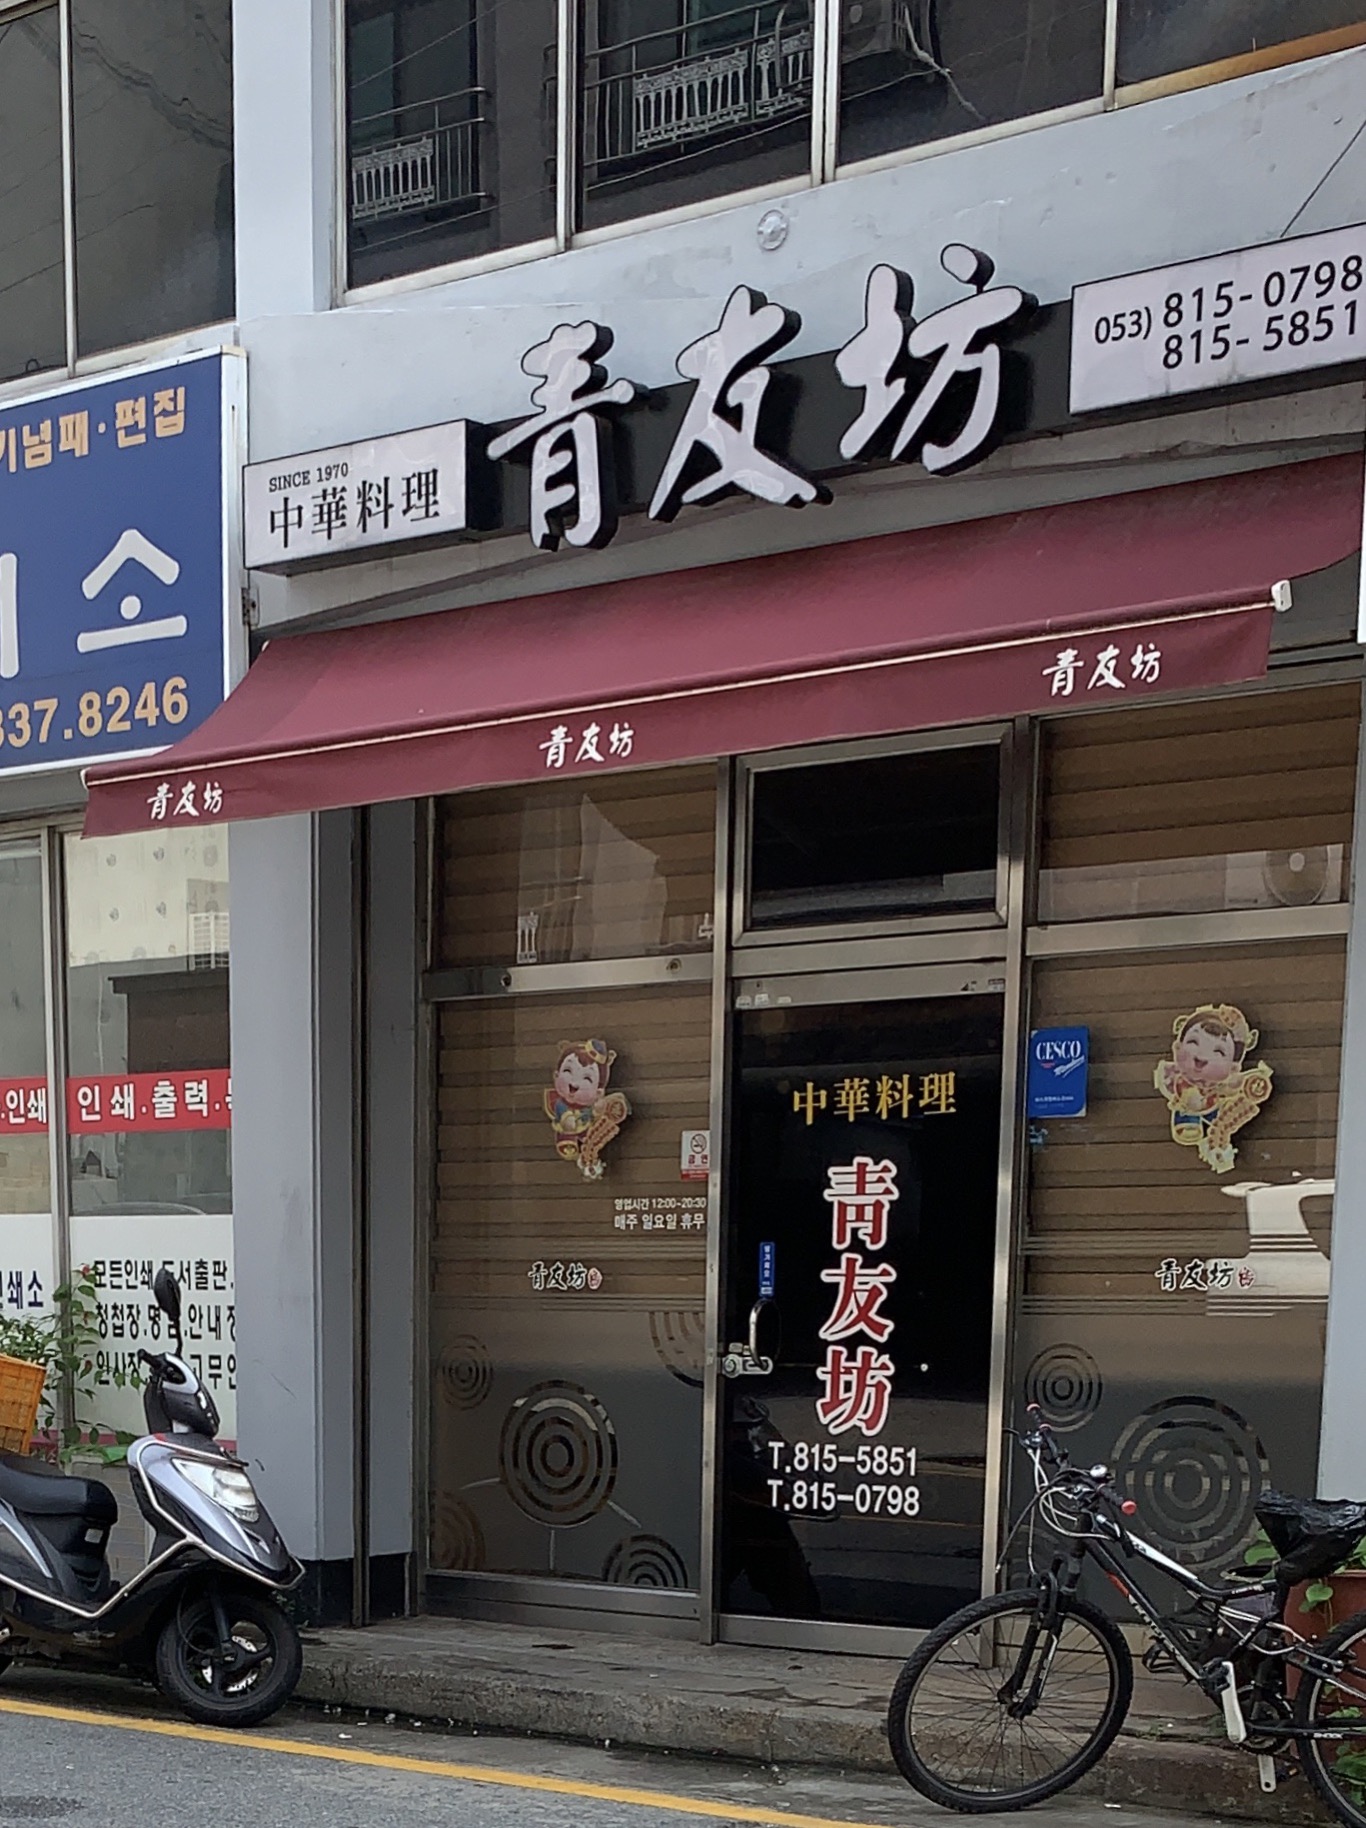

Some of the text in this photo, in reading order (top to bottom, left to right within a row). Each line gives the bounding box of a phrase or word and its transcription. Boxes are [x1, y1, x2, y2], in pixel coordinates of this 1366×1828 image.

[1095, 255, 1363, 344] 053) 815-0798
[1162, 299, 1357, 369] 815-5851
[269, 462, 349, 493] SINCE 1970
[270, 468, 440, 549] 中華料理
[1035, 1040, 1081, 1060] CESCO
[793, 1071, 956, 1126] 中華料理
[614, 1213, 705, 1230] 매주 일요일 휴무
[768, 1441, 917, 1476] T.815-5851
[767, 1479, 920, 1516] T.815-0798
